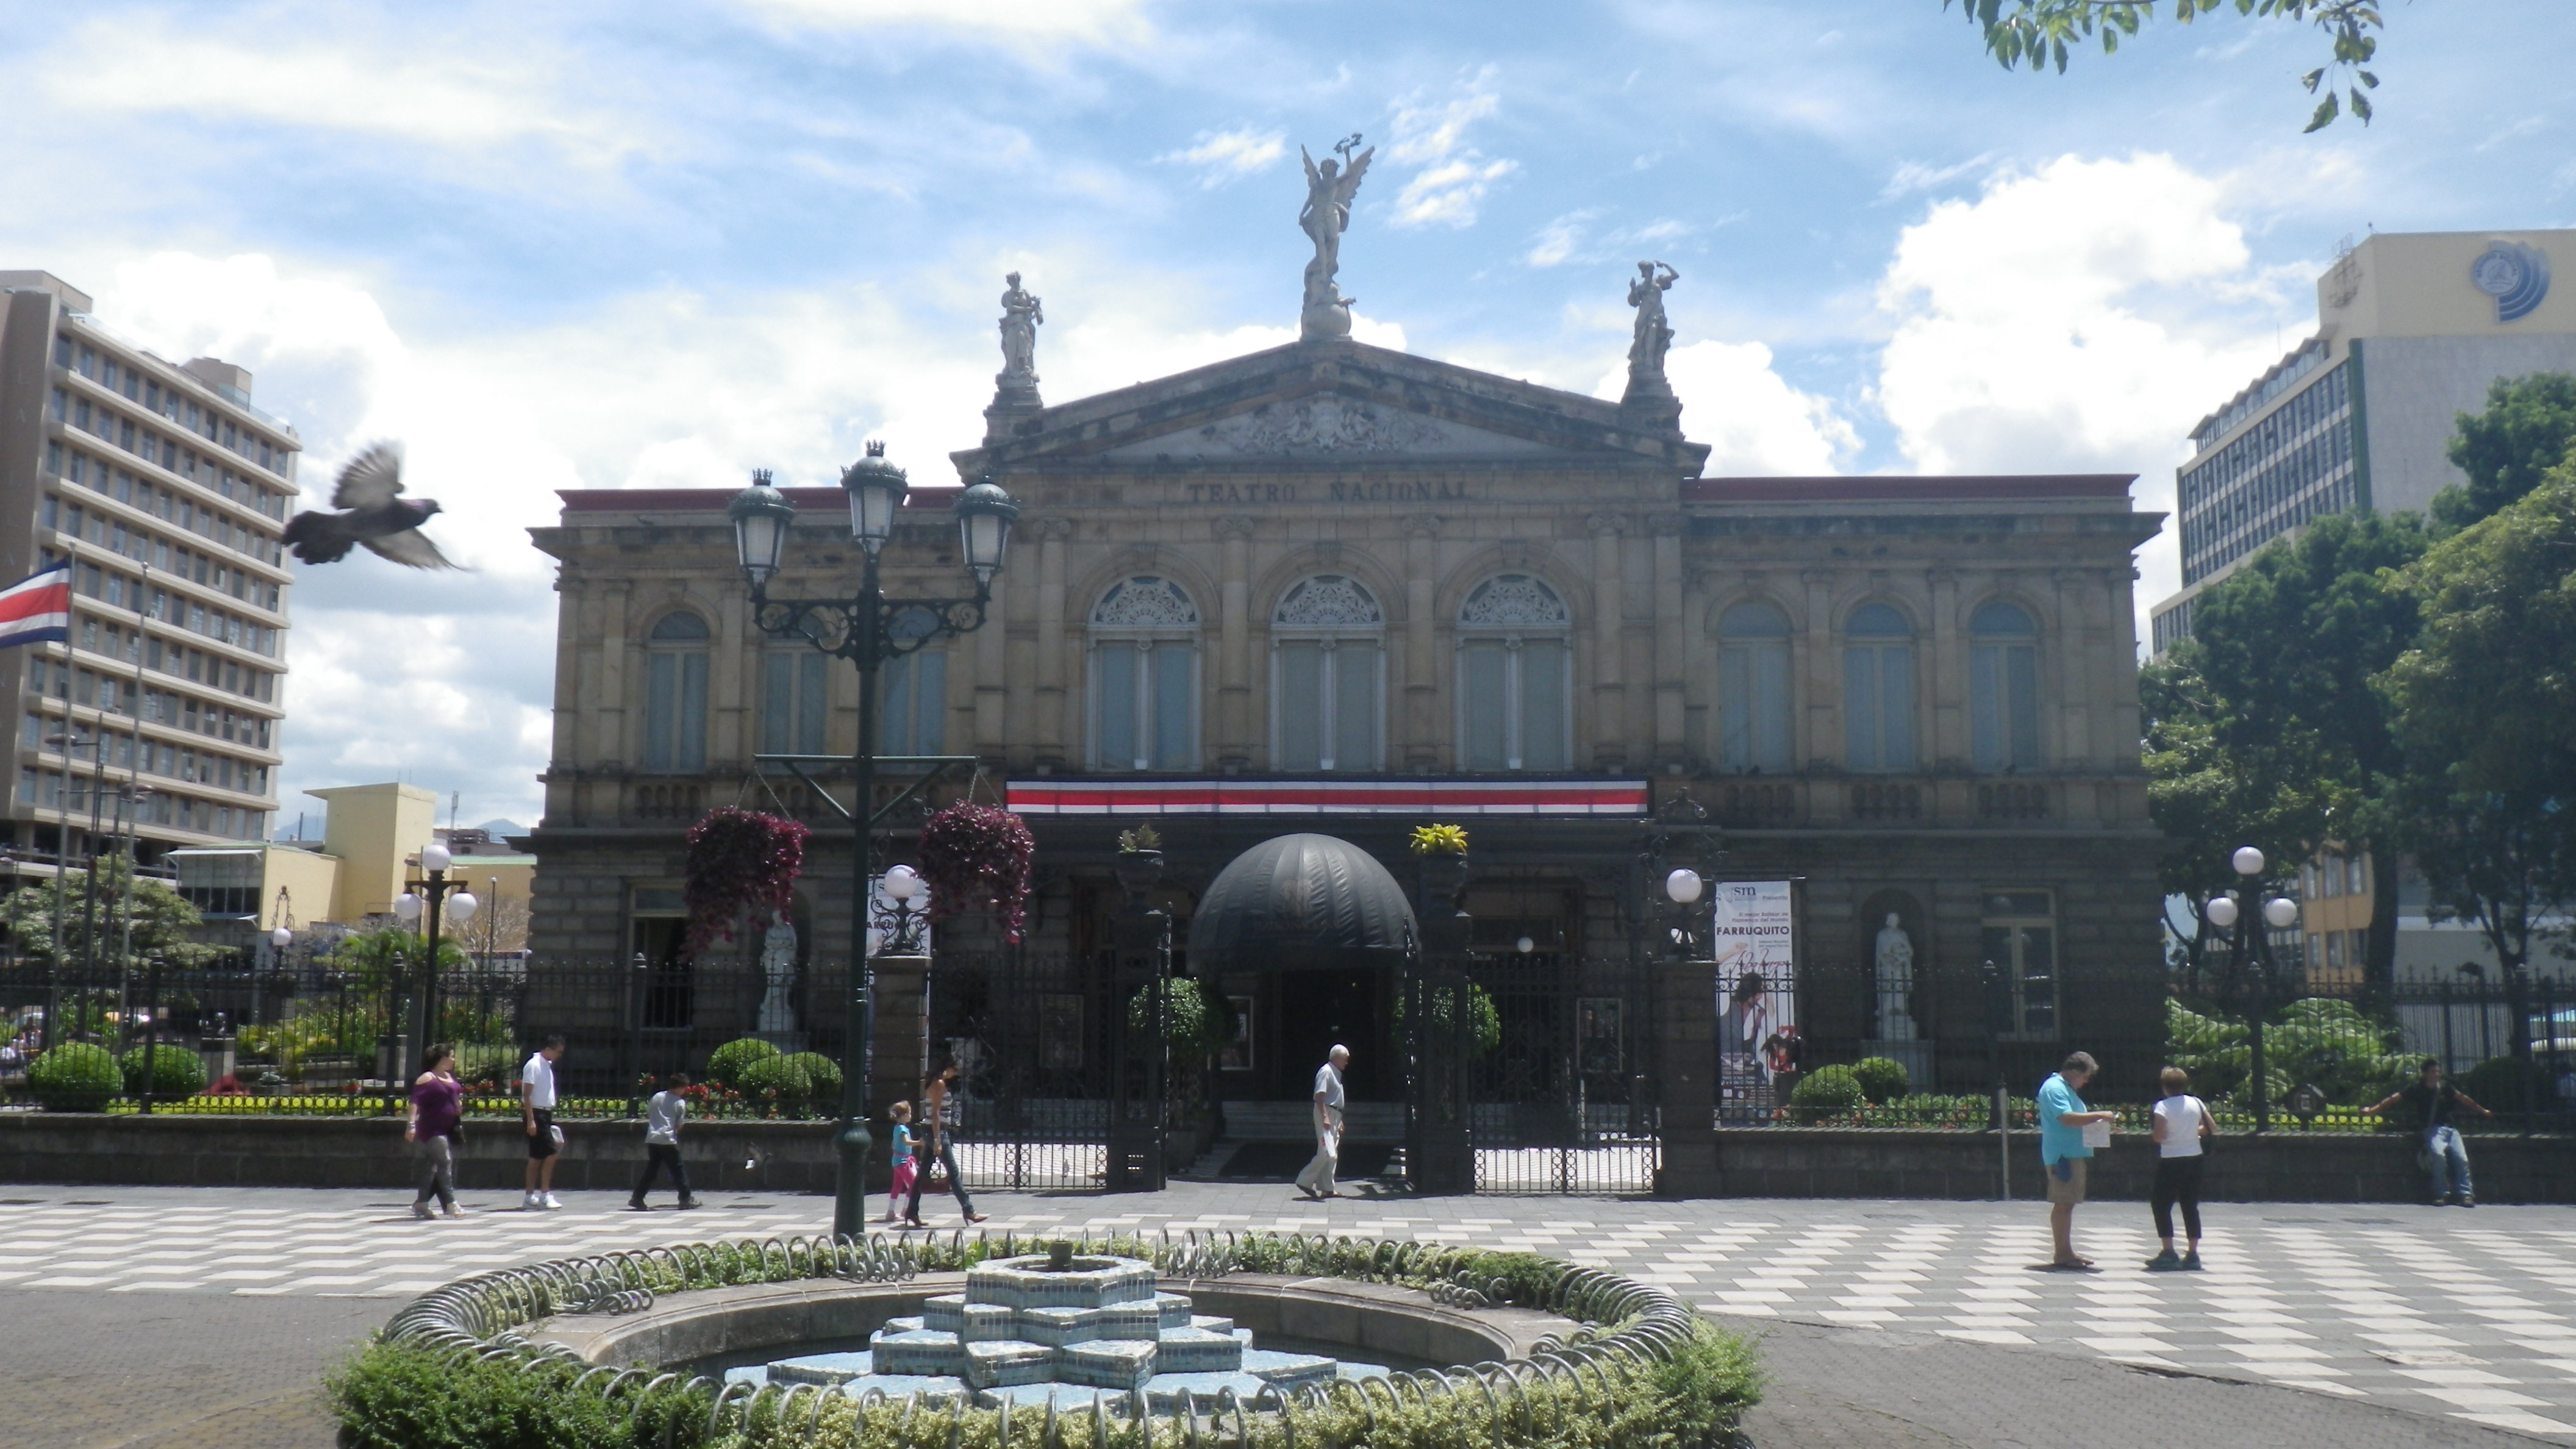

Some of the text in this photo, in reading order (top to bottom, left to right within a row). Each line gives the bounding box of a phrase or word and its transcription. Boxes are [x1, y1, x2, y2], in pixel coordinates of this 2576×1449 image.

[1189, 482, 1471, 503] TEATRO NACIONAL
[1716, 926, 1789, 936] FARRUQUITO
